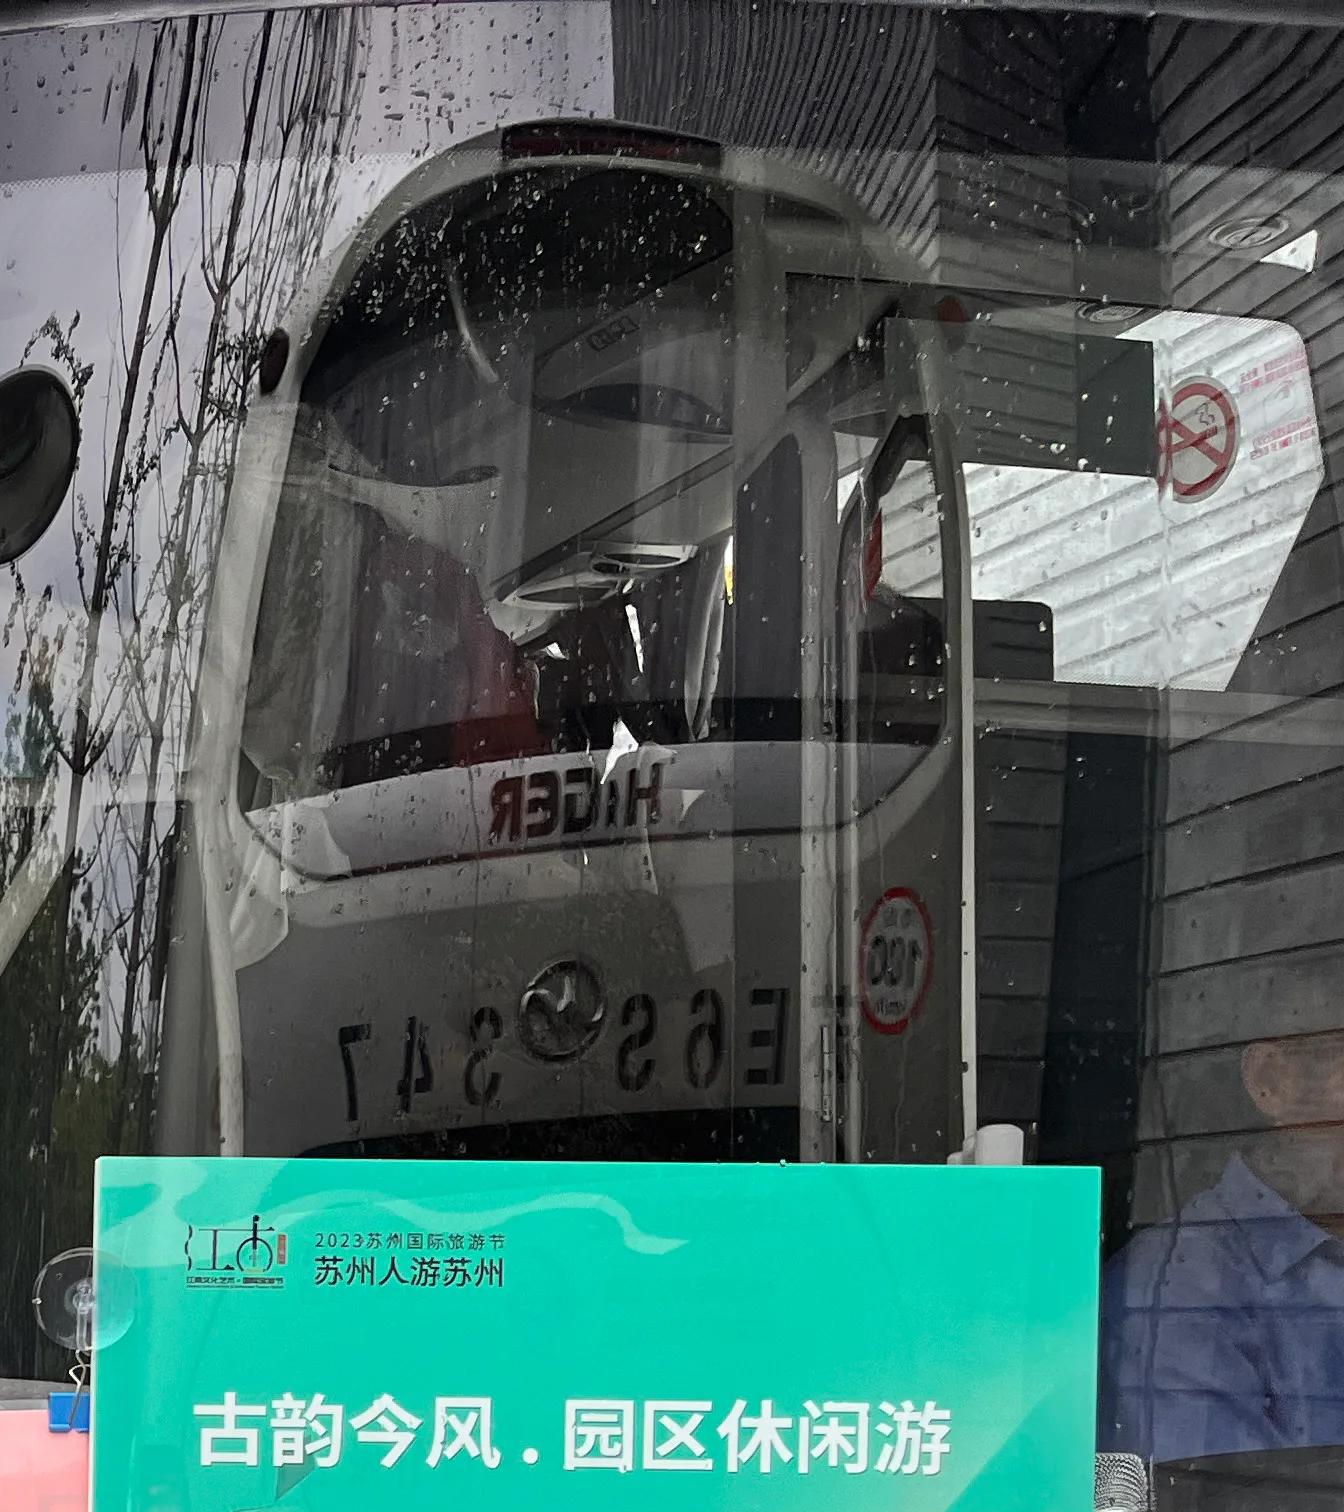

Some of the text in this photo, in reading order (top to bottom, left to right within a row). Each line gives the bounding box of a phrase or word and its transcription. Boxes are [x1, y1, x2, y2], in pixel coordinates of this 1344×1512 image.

[314, 1232, 507, 1251] 2023苏州国际旅游节
[314, 1256, 504, 1288] 苏州人游苏州
